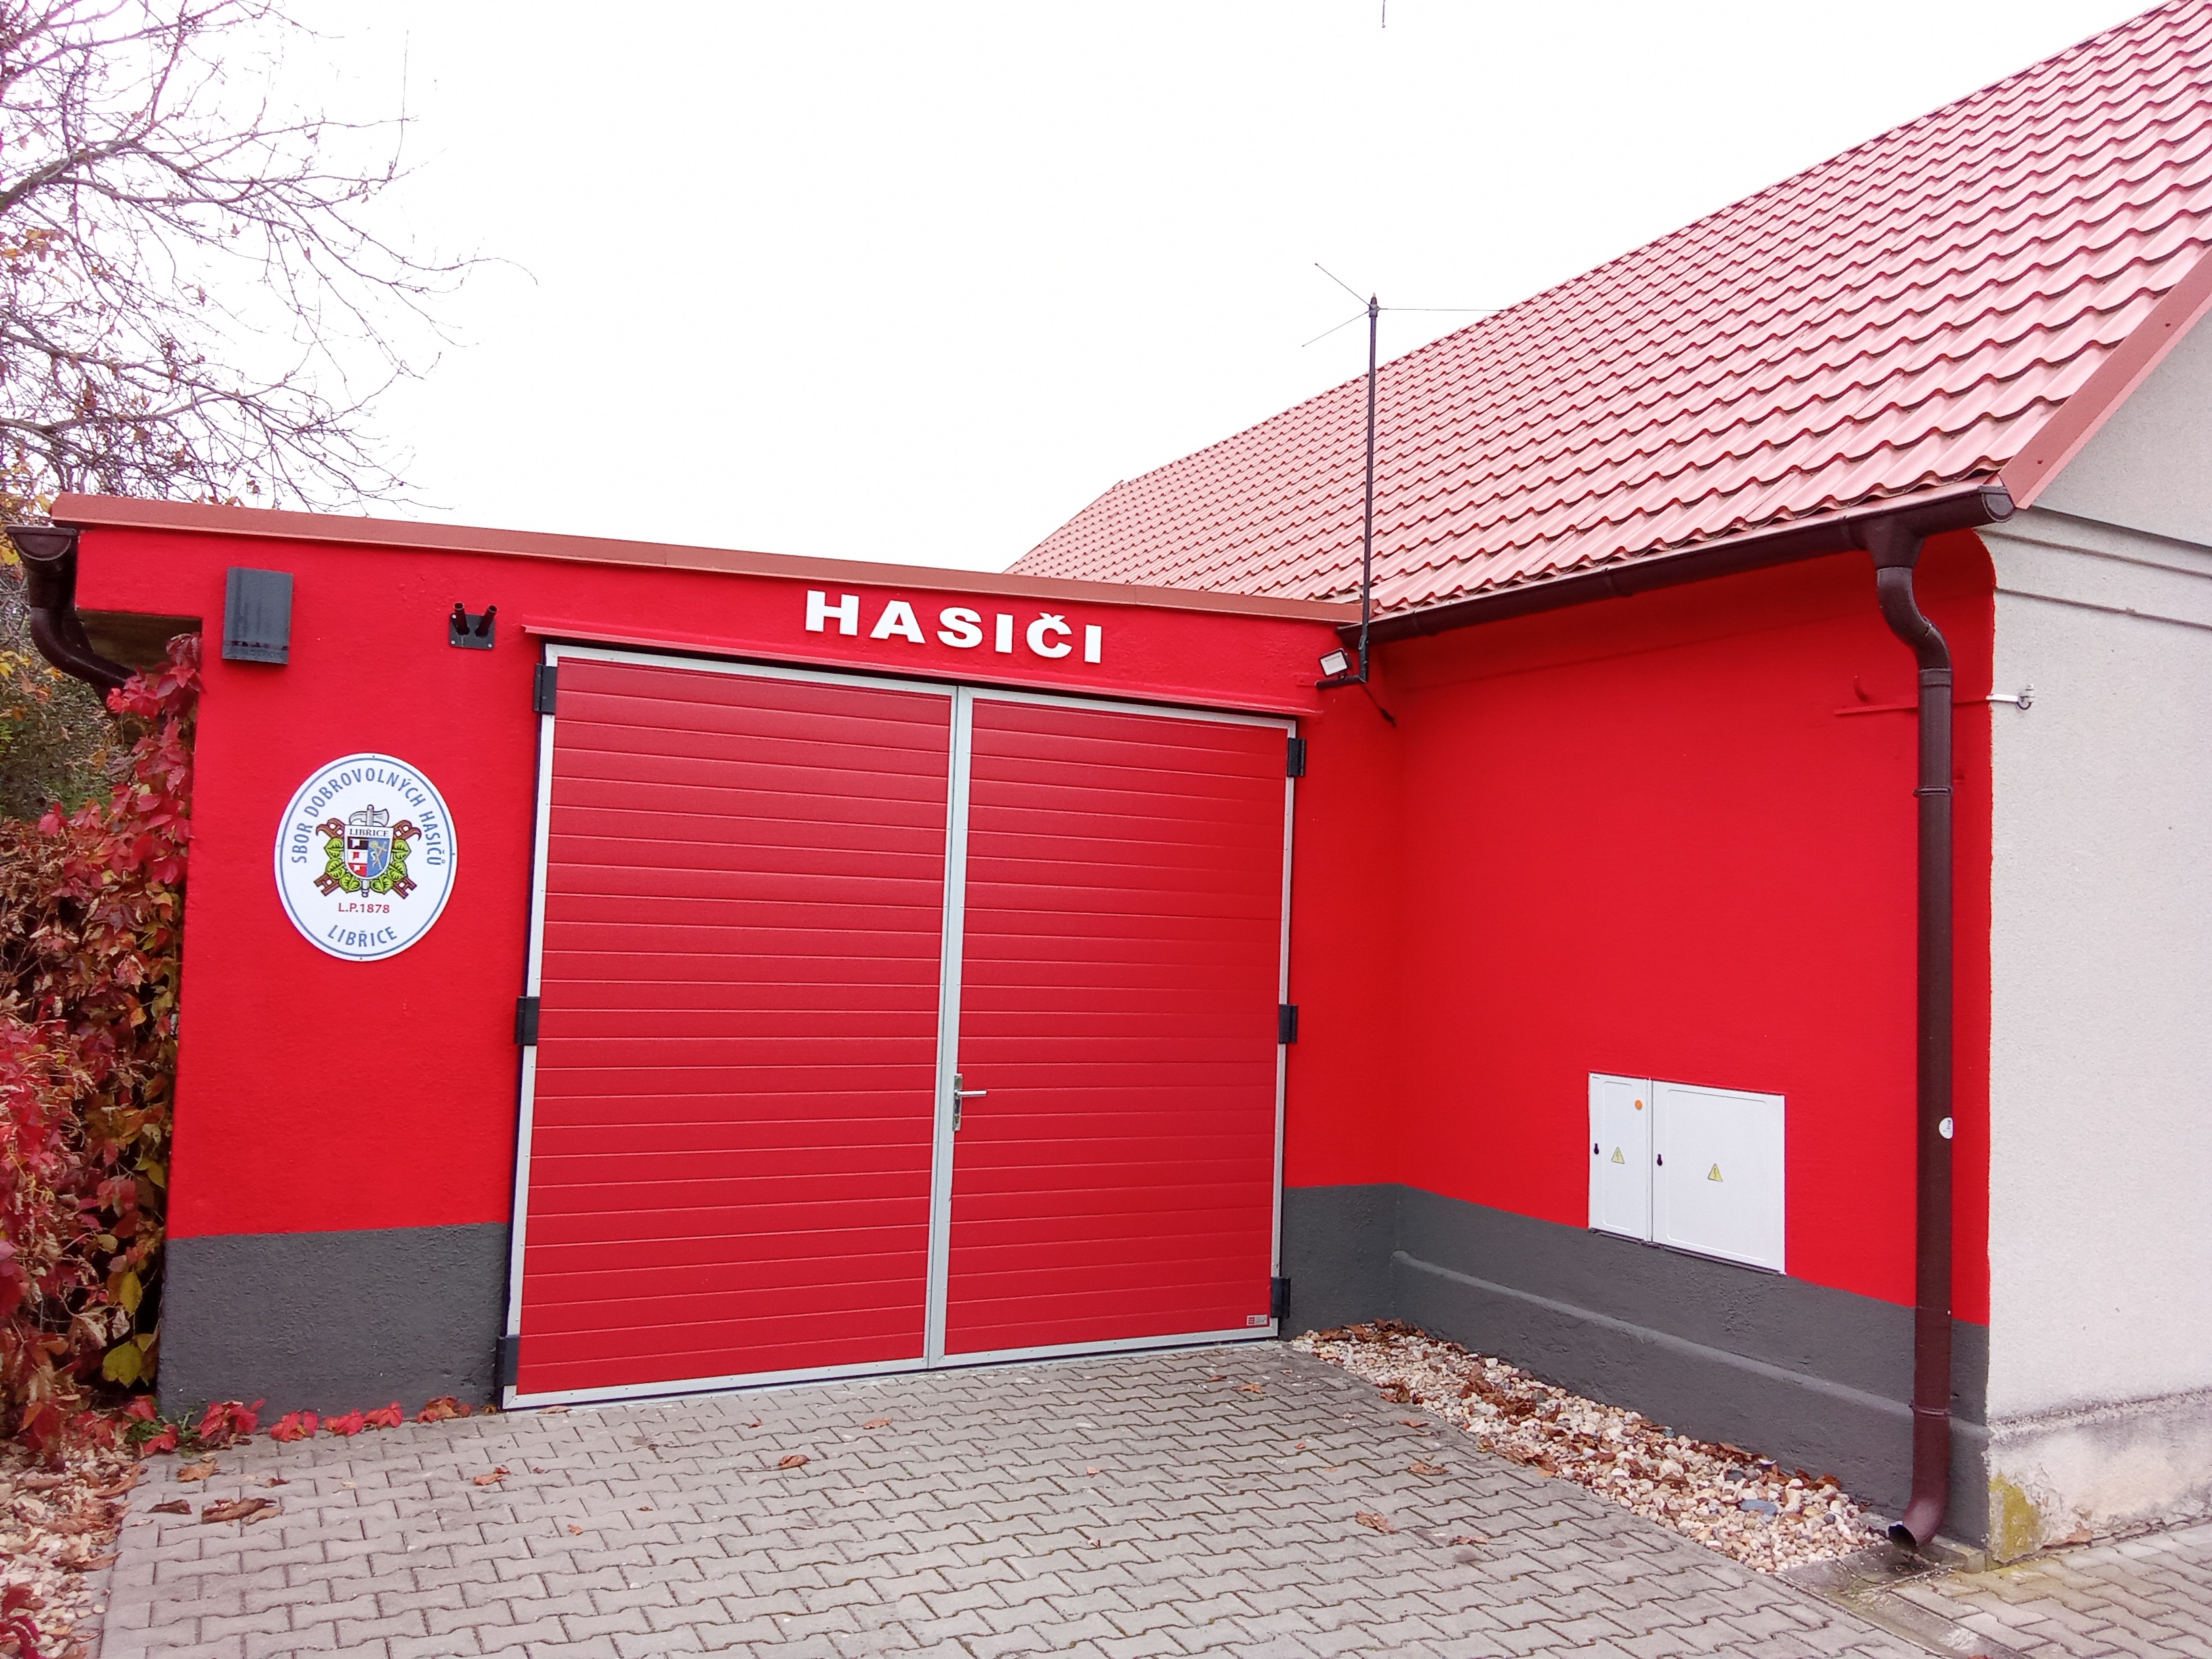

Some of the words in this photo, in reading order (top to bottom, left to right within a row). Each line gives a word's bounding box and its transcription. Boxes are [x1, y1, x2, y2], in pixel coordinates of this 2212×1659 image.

[805, 590, 1102, 663] HASIČI
[291, 822, 313, 863] SBOR
[304, 767, 426, 818] DOBROVOLNÝCH
[419, 811, 446, 866] HASIČŮ
[349, 827, 390, 838] LIBŘICE
[338, 903, 390, 914] L.P.1878
[327, 924, 397, 947] LIBŘICE
